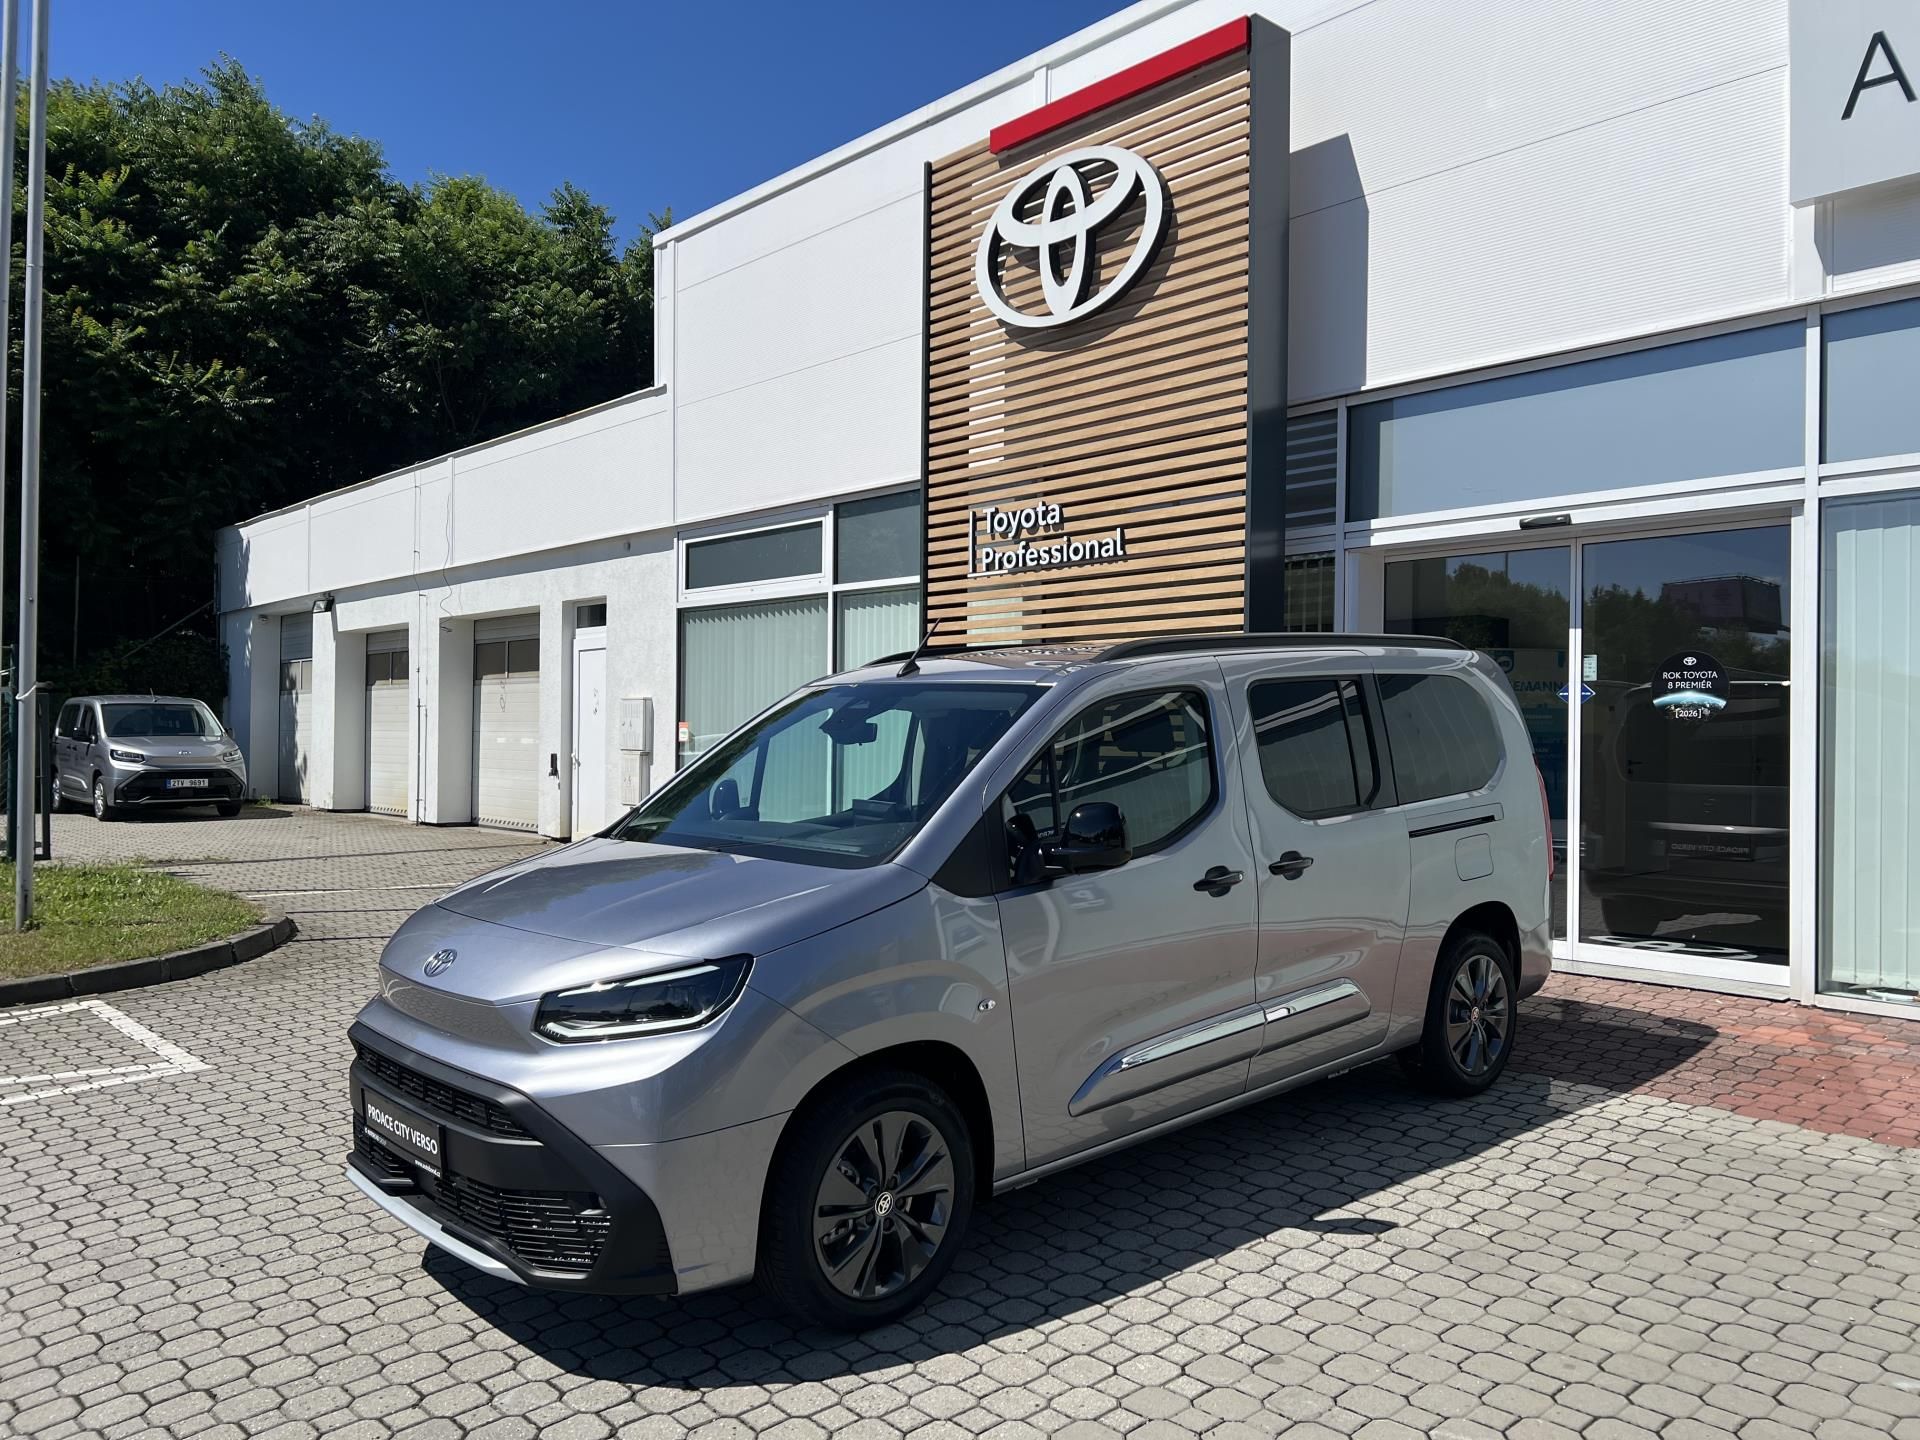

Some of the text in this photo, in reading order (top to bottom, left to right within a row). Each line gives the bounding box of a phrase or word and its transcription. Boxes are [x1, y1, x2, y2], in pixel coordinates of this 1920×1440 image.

[982, 500, 1060, 537] Toyota
[982, 528, 1124, 572] Professional
[1662, 670, 1718, 680] ROK TOYOTA
[1667, 679, 1712, 689] 8 PREMIÉR
[367, 1103, 394, 1131] PROACE
[393, 1120, 410, 1141] CITY
[410, 1127, 438, 1155] VERSO
